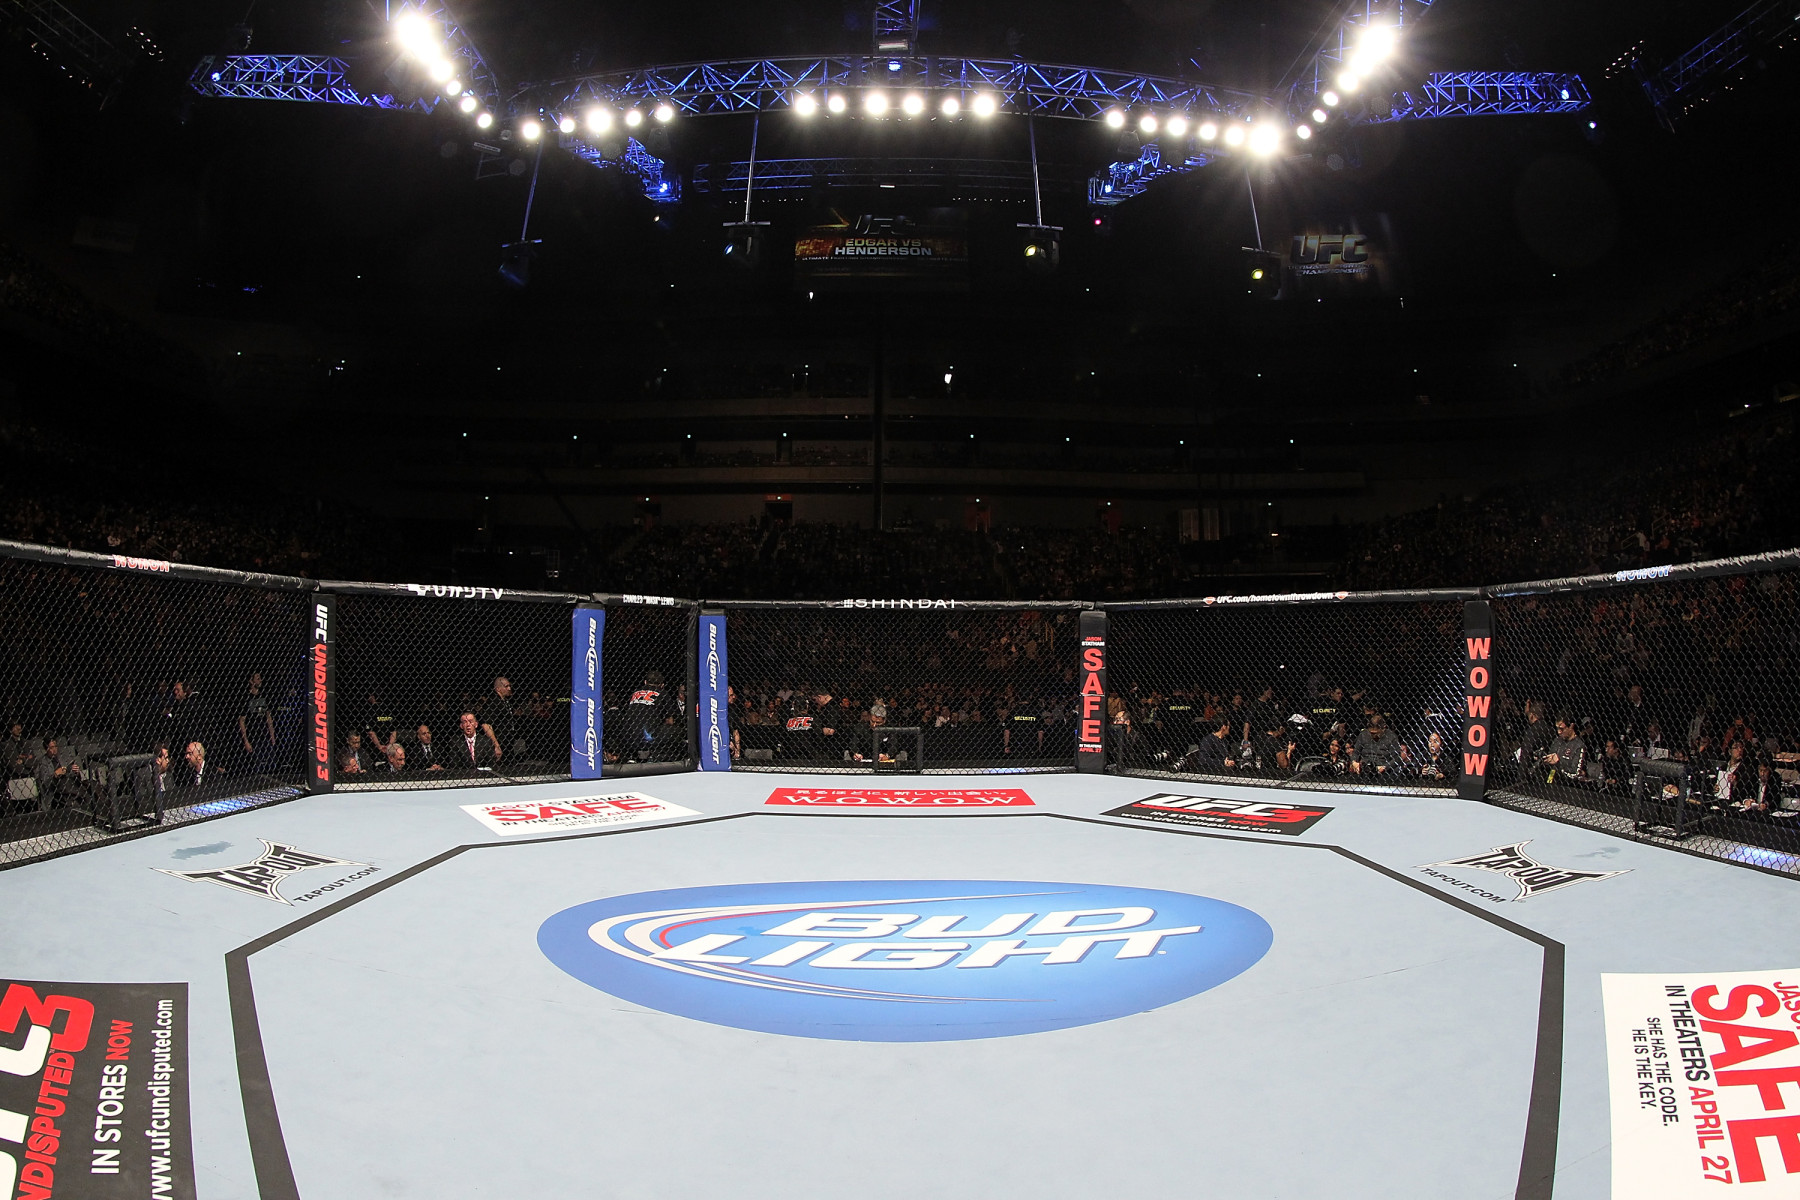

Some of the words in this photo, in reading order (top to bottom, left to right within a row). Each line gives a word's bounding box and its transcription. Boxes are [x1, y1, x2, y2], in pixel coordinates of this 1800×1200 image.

[835, 247, 932, 256] HENDERSON
[845, 239, 897, 247] EDGAR
[902, 239, 922, 247] VS
[1290, 234, 1368, 264] UFC
[855, 599, 955, 609] SHINDAI
[315, 604, 328, 642] UFC
[587, 617, 597, 647] BUD
[708, 622, 718, 651] BUD
[586, 649, 597, 691] LIGHT
[708, 653, 718, 692] LIGHT
[314, 644, 328, 762] UNDISPUTED
[1081, 648, 1105, 743] SAFE
[1463, 637, 1491, 776] WOWOW
[586, 697, 596, 727] BUD
[709, 697, 719, 727] BUD
[586, 730, 597, 771] LIGHT
[710, 729, 720, 765] LIGHT
[316, 767, 329, 781] 3
[488, 798, 661, 822] SAFE
[783, 796, 1017, 805] WOWOW
[1140, 795, 1295, 817] UFC
[1243, 808, 1325, 824] 3
[1121, 813, 1282, 834] www.ufcundisputed.com
[1168, 813, 1226, 823] STORES
[1227, 819, 1269, 827] NOW
[183, 844, 338, 895] TAPOUT
[1449, 846, 1608, 892] TAPOUT
[294, 866, 382, 903] TAPOUT.COM
[1420, 867, 1507, 904] TAPOUT.COM
[760, 906, 1158, 938] BUD
[649, 925, 1205, 970] LIGHT
[1665, 985, 1687, 997] IN
[106, 1019, 134, 1060] NOW
[1632, 1029, 1647, 1042] HE
[1647, 1017, 1662, 1035] SHE
[1634, 1045, 1649, 1055] IS
[1651, 1038, 1667, 1059] HAS
[1669, 1001, 1711, 1082] THEATERS
[1635, 1057, 1653, 1079] THE
[1655, 1062, 1673, 1083] THE
[1638, 1082, 1657, 1109] KEY.
[1691, 984, 1800, 1184] SAFE
[94, 1064, 128, 1143] STORES
[1658, 1087, 1679, 1127] CODE.
[1688, 1086, 1724, 1149] APRIL
[17, 1052, 75, 1200] NDISPUTED
[91, 1150, 120, 1174] IN
[1701, 1155, 1733, 1184] 27
